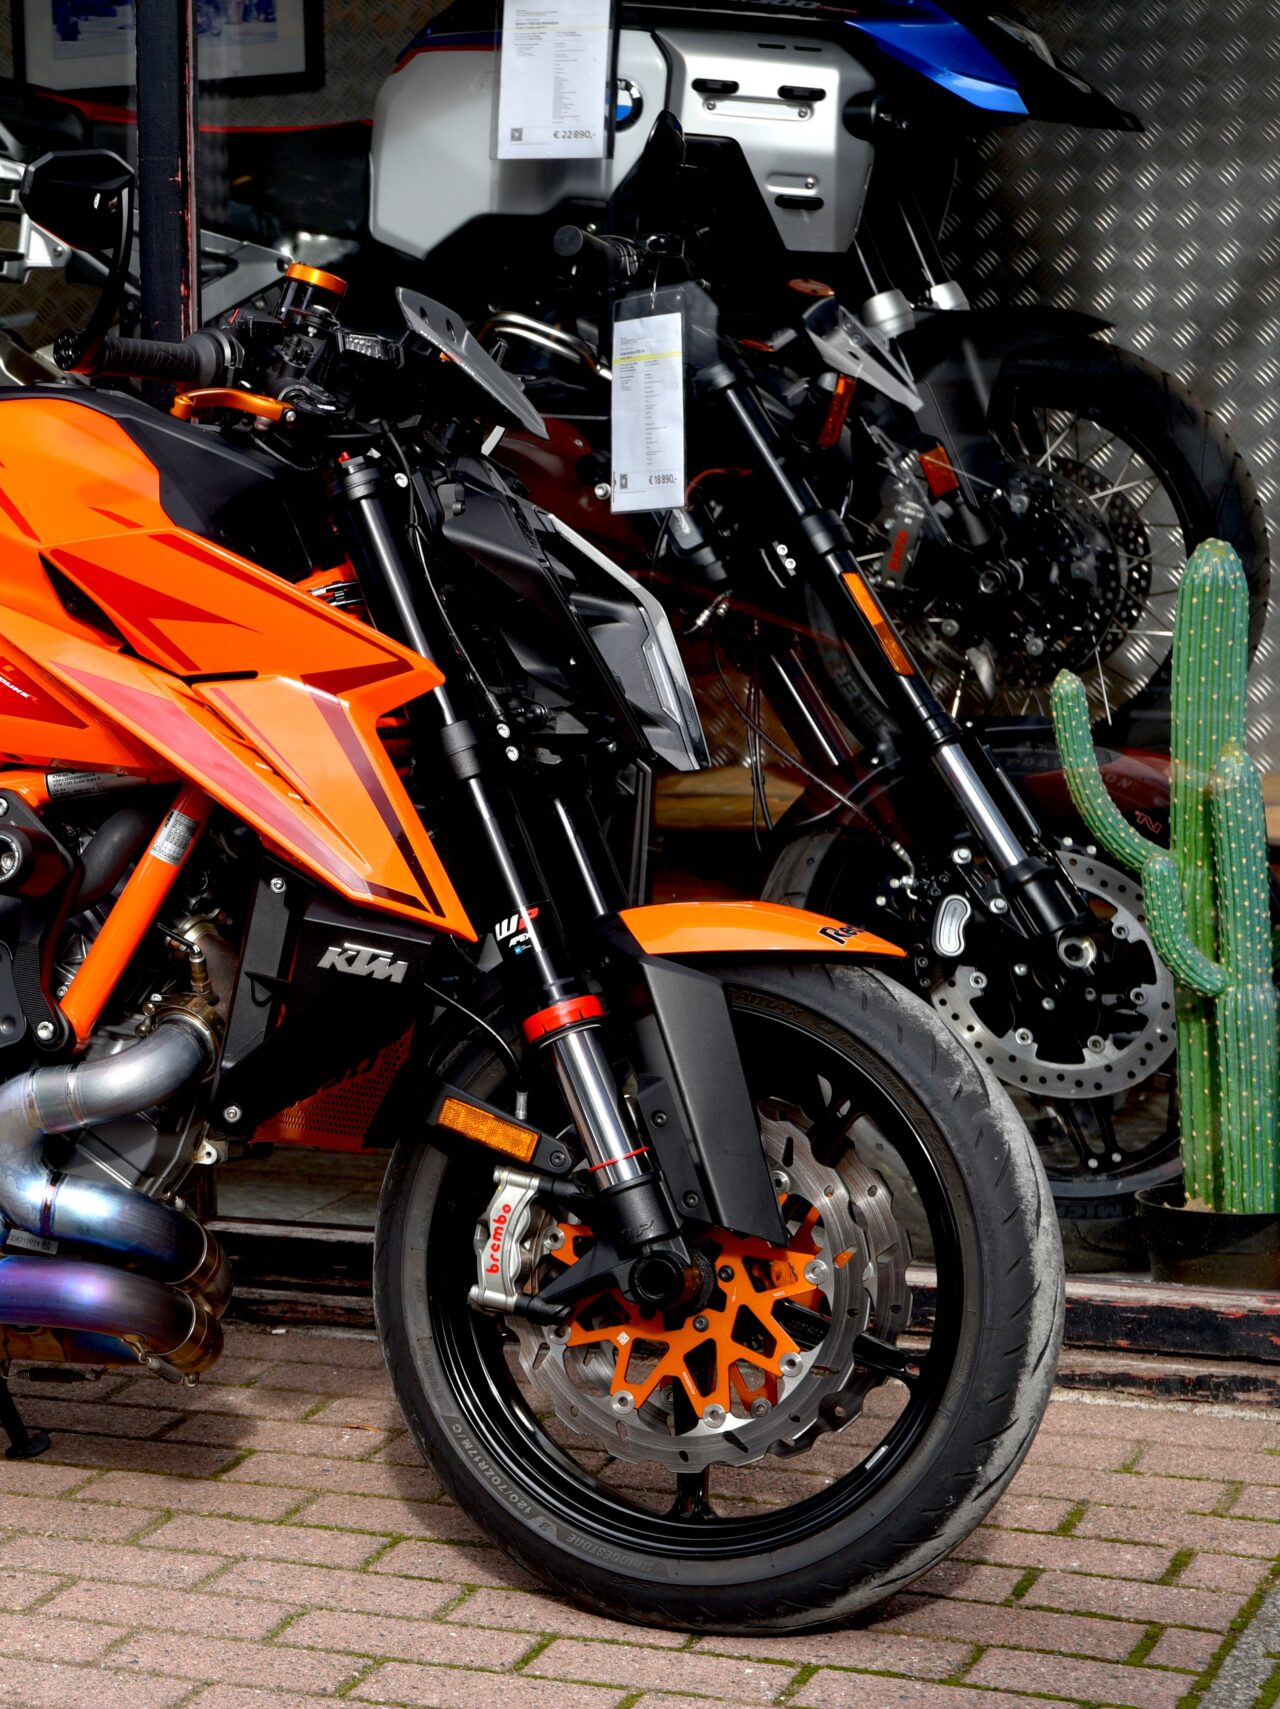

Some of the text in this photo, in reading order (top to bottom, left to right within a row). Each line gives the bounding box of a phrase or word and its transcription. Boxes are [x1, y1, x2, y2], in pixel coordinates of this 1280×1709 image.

[316, 942, 409, 984] KTM
[485, 1203, 512, 1275] brembo
[565, 1532, 655, 1572] BRIDGESTONE
